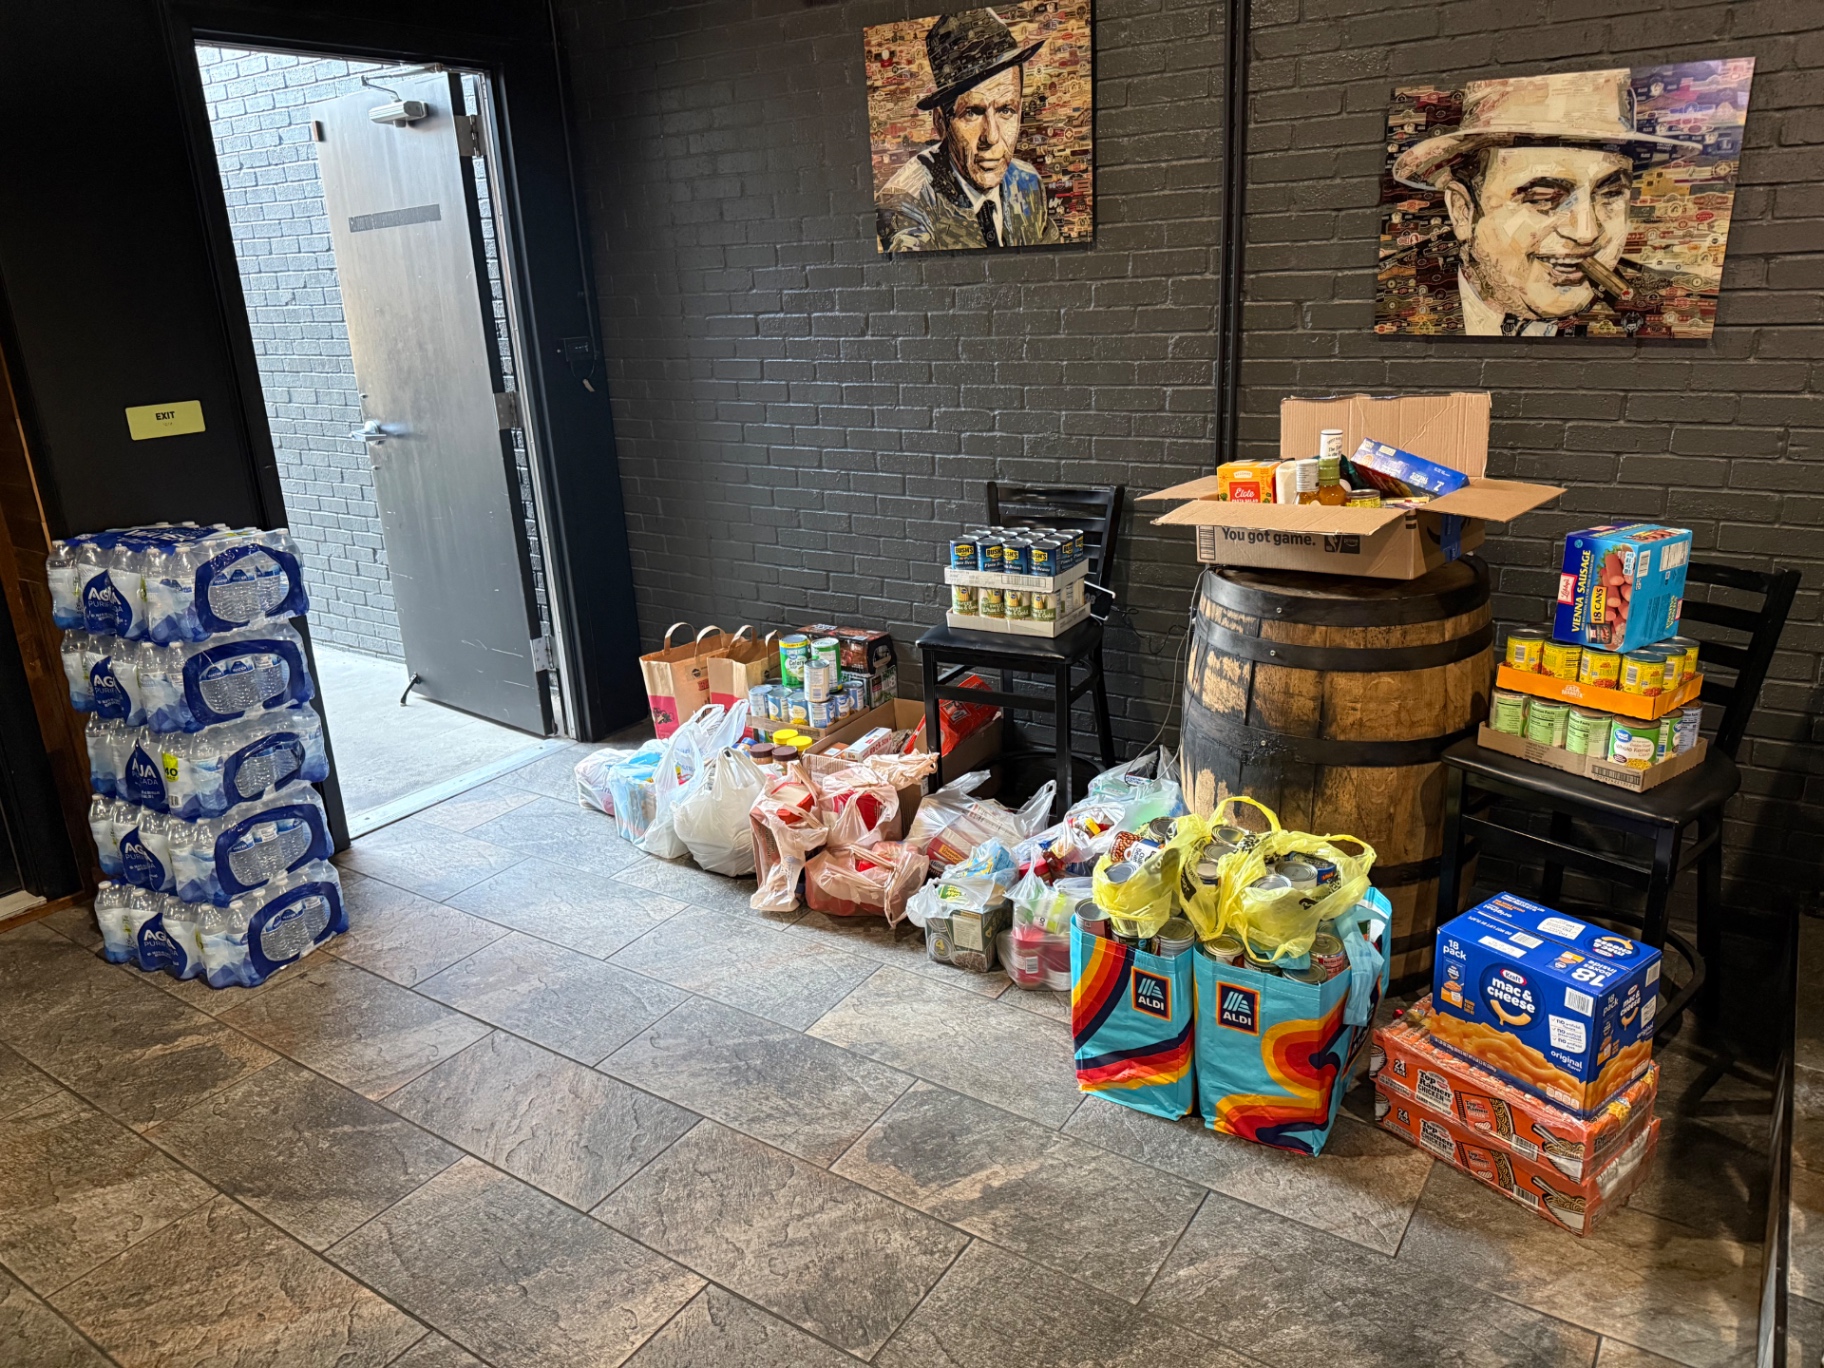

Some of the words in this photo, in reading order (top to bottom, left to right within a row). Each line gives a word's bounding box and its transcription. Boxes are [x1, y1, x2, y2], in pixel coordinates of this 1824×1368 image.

[155, 411, 175, 421] EXIT
[1221, 527, 1244, 541] You
[1247, 530, 1270, 544] got
[1274, 532, 1316, 548] game.
[955, 546, 974, 554] BUSH'S
[987, 548, 1003, 556] BUSH
[1577, 549, 1591, 594] SAUSAGE
[1594, 587, 1604, 611] CANS
[1571, 597, 1584, 633] VIENNA
[1593, 611, 1602, 622] 18
[1616, 743, 1632, 752] Whole
[1448, 939, 1459, 951] 18
[1443, 945, 1466, 962] pack
[1583, 964, 1611, 978] boxes
[1588, 960, 1617, 975] inside
[1504, 971, 1521, 983] Kraft
[1571, 967, 1604, 987] 18
[1492, 977, 1521, 997] mac
[1521, 989, 1533, 1003] &
[1138, 997, 1164, 1011] ALDI
[1223, 1011, 1252, 1026] ALDI
[1556, 1018, 1565, 1026] no
[1557, 1037, 1566, 1045] no
[1394, 1059, 1405, 1072] 24
[1551, 1050, 1583, 1070] original
[1394, 1067, 1406, 1078] PACK
[1567, 1063, 1582, 1072] flavor
[1419, 1070, 1436, 1085] Top
[1417, 1084, 1446, 1103] CHICKEN
[1419, 1079, 1453, 1099] Ramen
[1397, 1107, 1408, 1119] 24
[1398, 1114, 1410, 1125] PACK
[1421, 1119, 1437, 1134] Top
[1421, 1127, 1453, 1147] Ramen
[1421, 1133, 1447, 1151] CHICKEN
